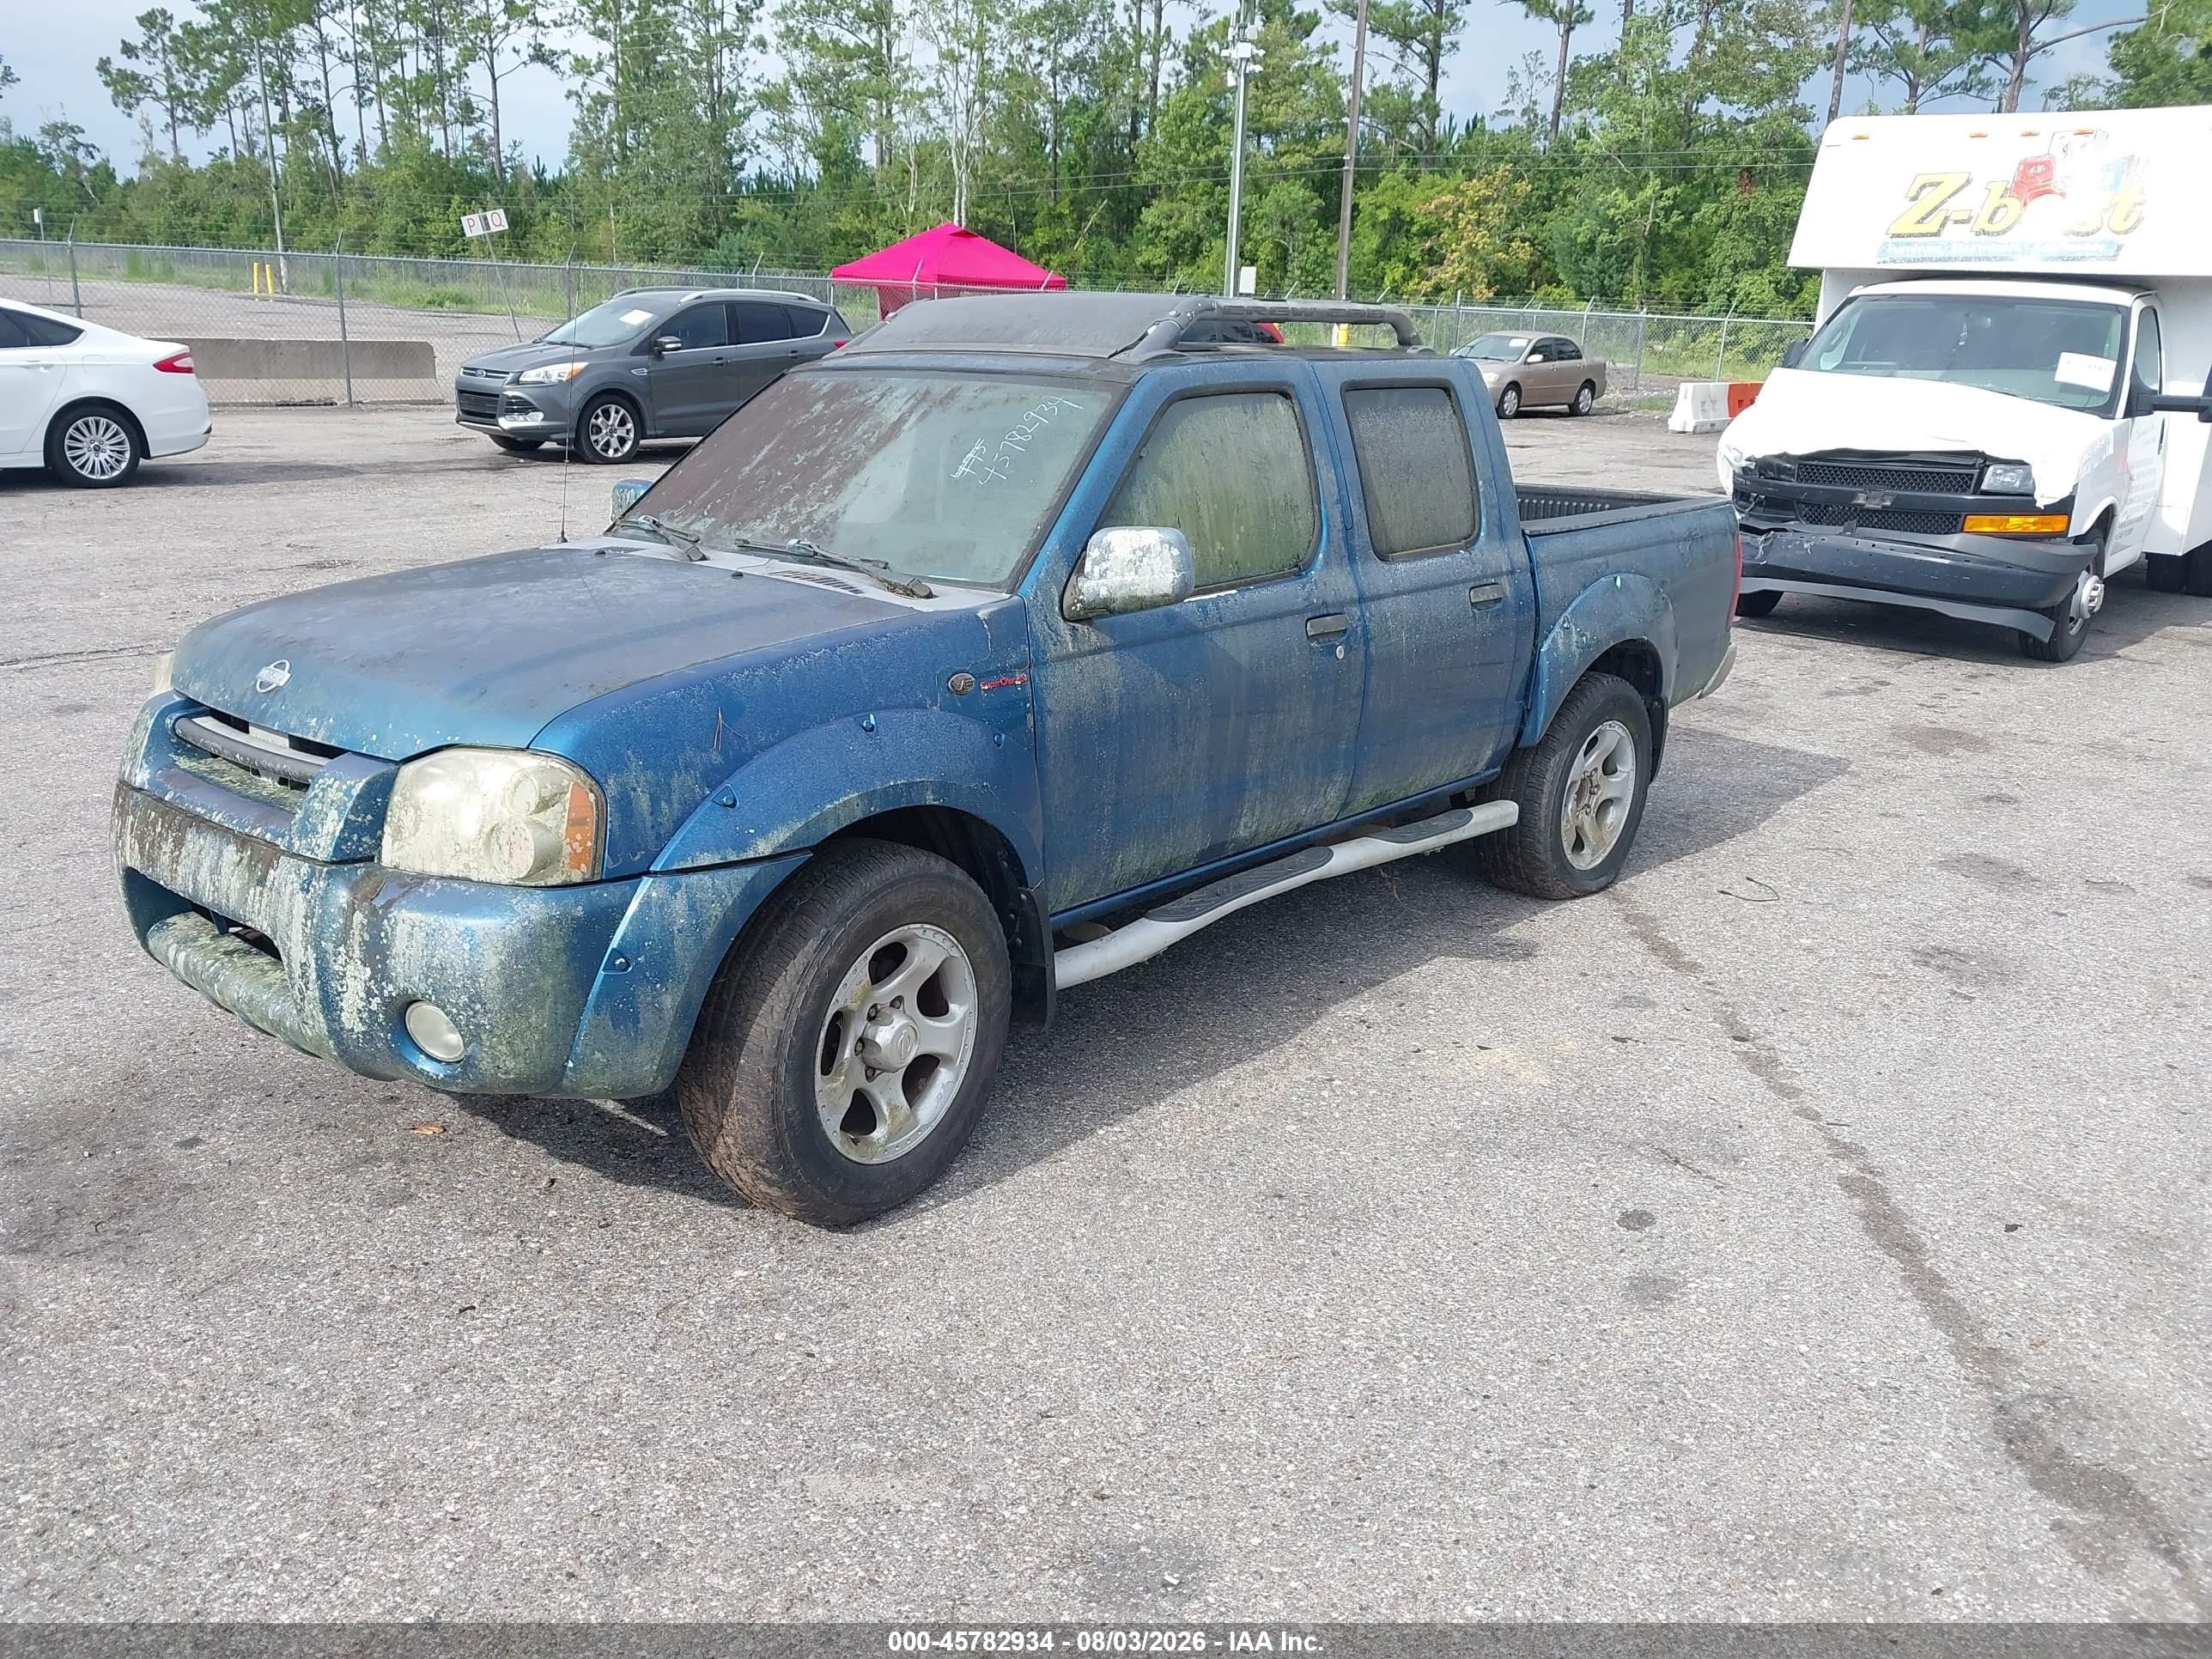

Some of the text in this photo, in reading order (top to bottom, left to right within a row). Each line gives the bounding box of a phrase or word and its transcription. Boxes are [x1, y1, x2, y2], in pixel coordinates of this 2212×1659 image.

[466, 211, 506, 234] P Q
[1222, 305, 1388, 319] CREW CAB
[978, 395, 1084, 485] 45782934
